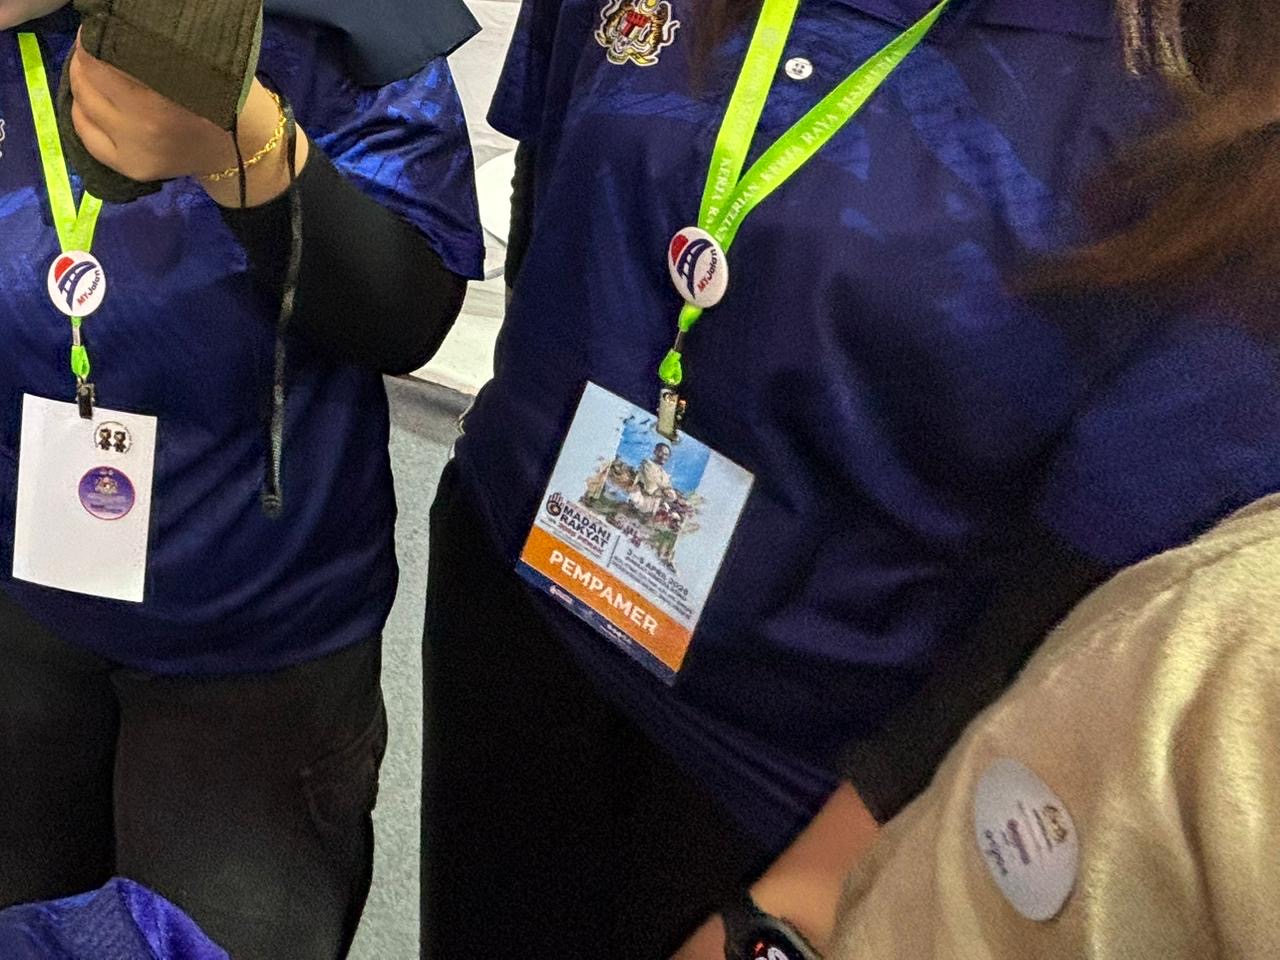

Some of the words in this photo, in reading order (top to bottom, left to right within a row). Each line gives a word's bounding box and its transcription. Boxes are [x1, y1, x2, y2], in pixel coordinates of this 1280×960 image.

[801, 113, 839, 145] RAYA
[76, 270, 101, 306] MYJalan
[697, 248, 718, 293] MYJalan
[560, 514, 609, 548] RAKYAT
[563, 505, 611, 541] MADANI
[549, 549, 660, 636] PEMPAMER
